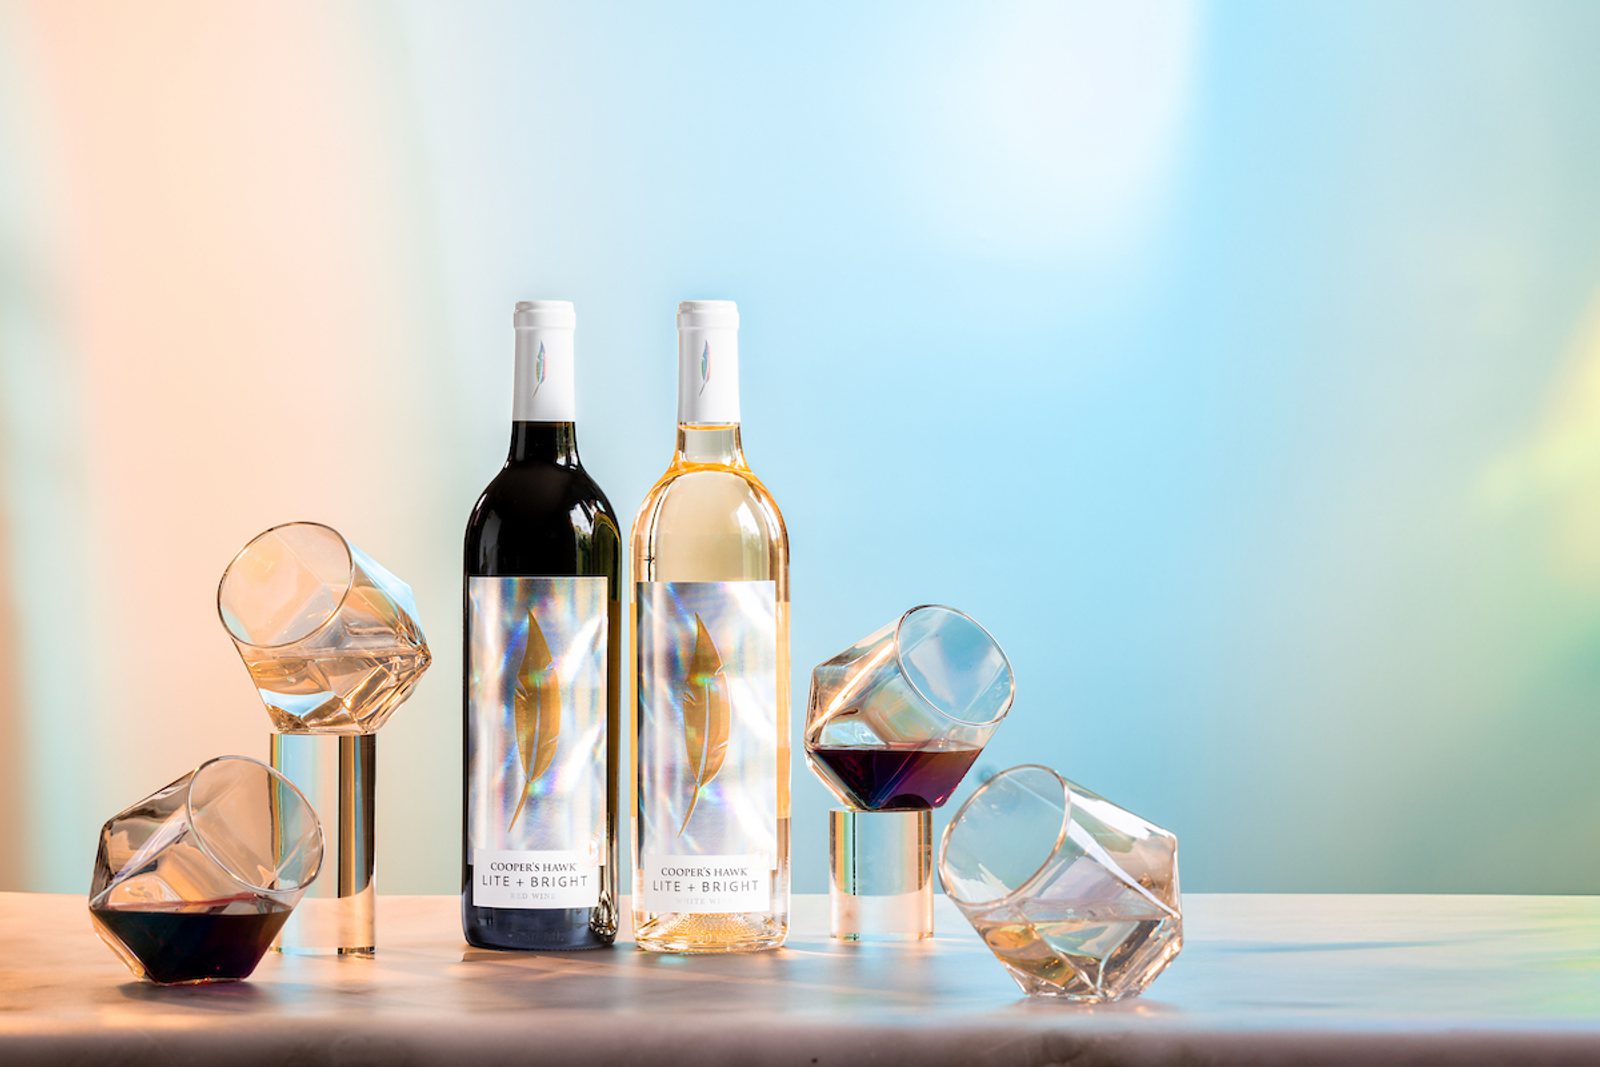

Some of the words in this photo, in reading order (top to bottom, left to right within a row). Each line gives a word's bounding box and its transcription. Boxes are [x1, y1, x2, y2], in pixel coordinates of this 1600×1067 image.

[490, 861, 540, 872] COOPER'S
[543, 862, 577, 872] HAWK
[661, 866, 711, 877] COOPER'S
[714, 867, 747, 877] HAWK
[482, 875, 510, 887] LITE
[516, 878, 524, 887] +
[530, 875, 588, 888] BRIGHT
[653, 879, 681, 892] LITE
[688, 883, 695, 892] +
[702, 879, 758, 893] BRIGHT
[531, 892, 556, 900] WINE
